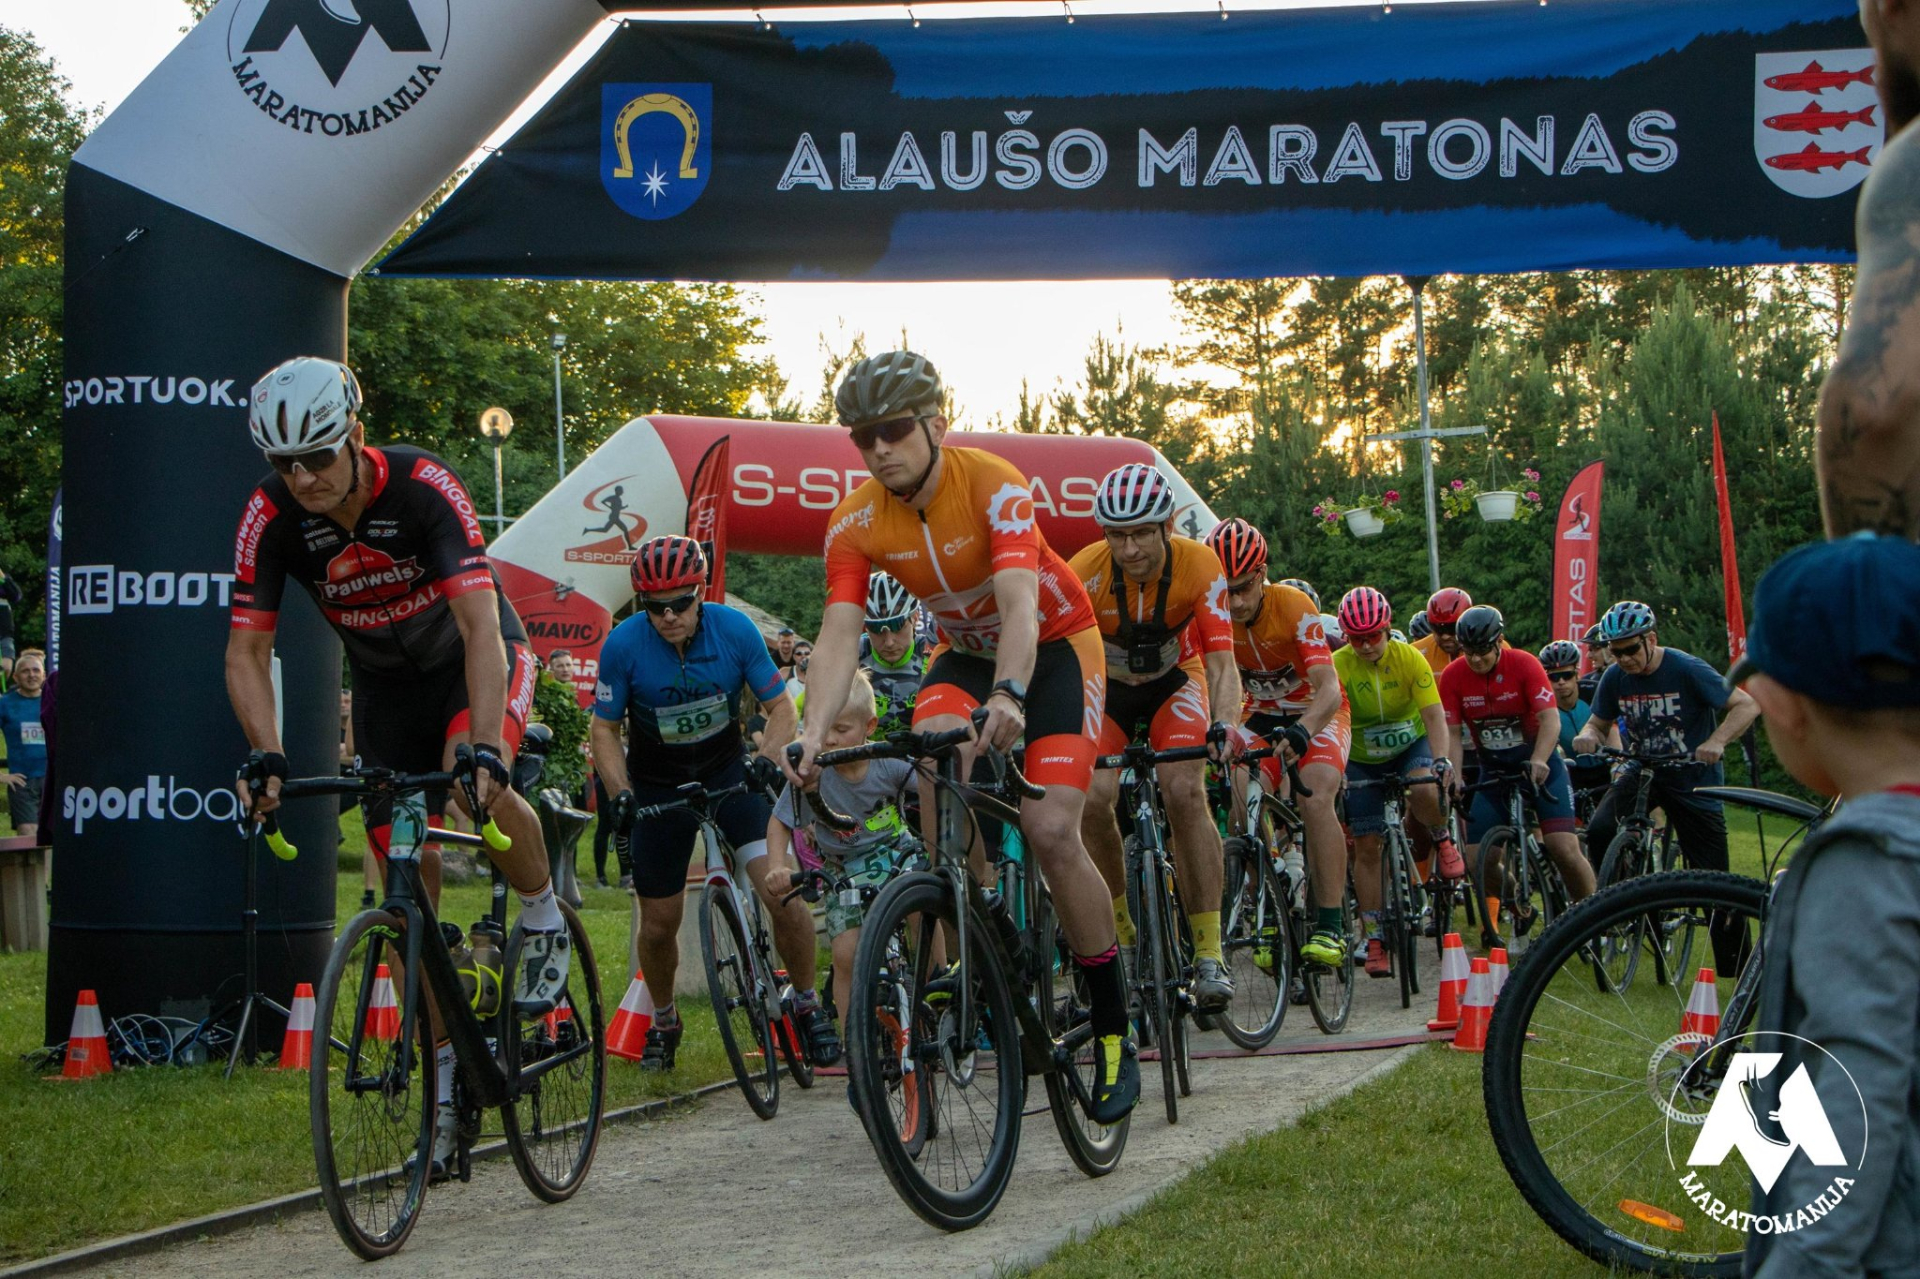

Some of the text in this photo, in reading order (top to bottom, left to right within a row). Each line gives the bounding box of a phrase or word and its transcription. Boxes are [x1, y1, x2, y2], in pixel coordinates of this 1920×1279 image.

[231, 56, 442, 136] MARATOMANIJA
[776, 110, 1678, 191] ALAUŠO MARATONAS
[244, 513, 268, 567] sauzen
[885, 550, 919, 561] TRIMTEX
[324, 566, 415, 599] Pauwels
[526, 622, 593, 641] MAVIC
[1249, 677, 1290, 692] 911
[676, 713, 712, 735] 89
[1371, 731, 1412, 748] 100
[1481, 727, 1514, 741] 931
[1040, 756, 1075, 764] TRIMTEX
